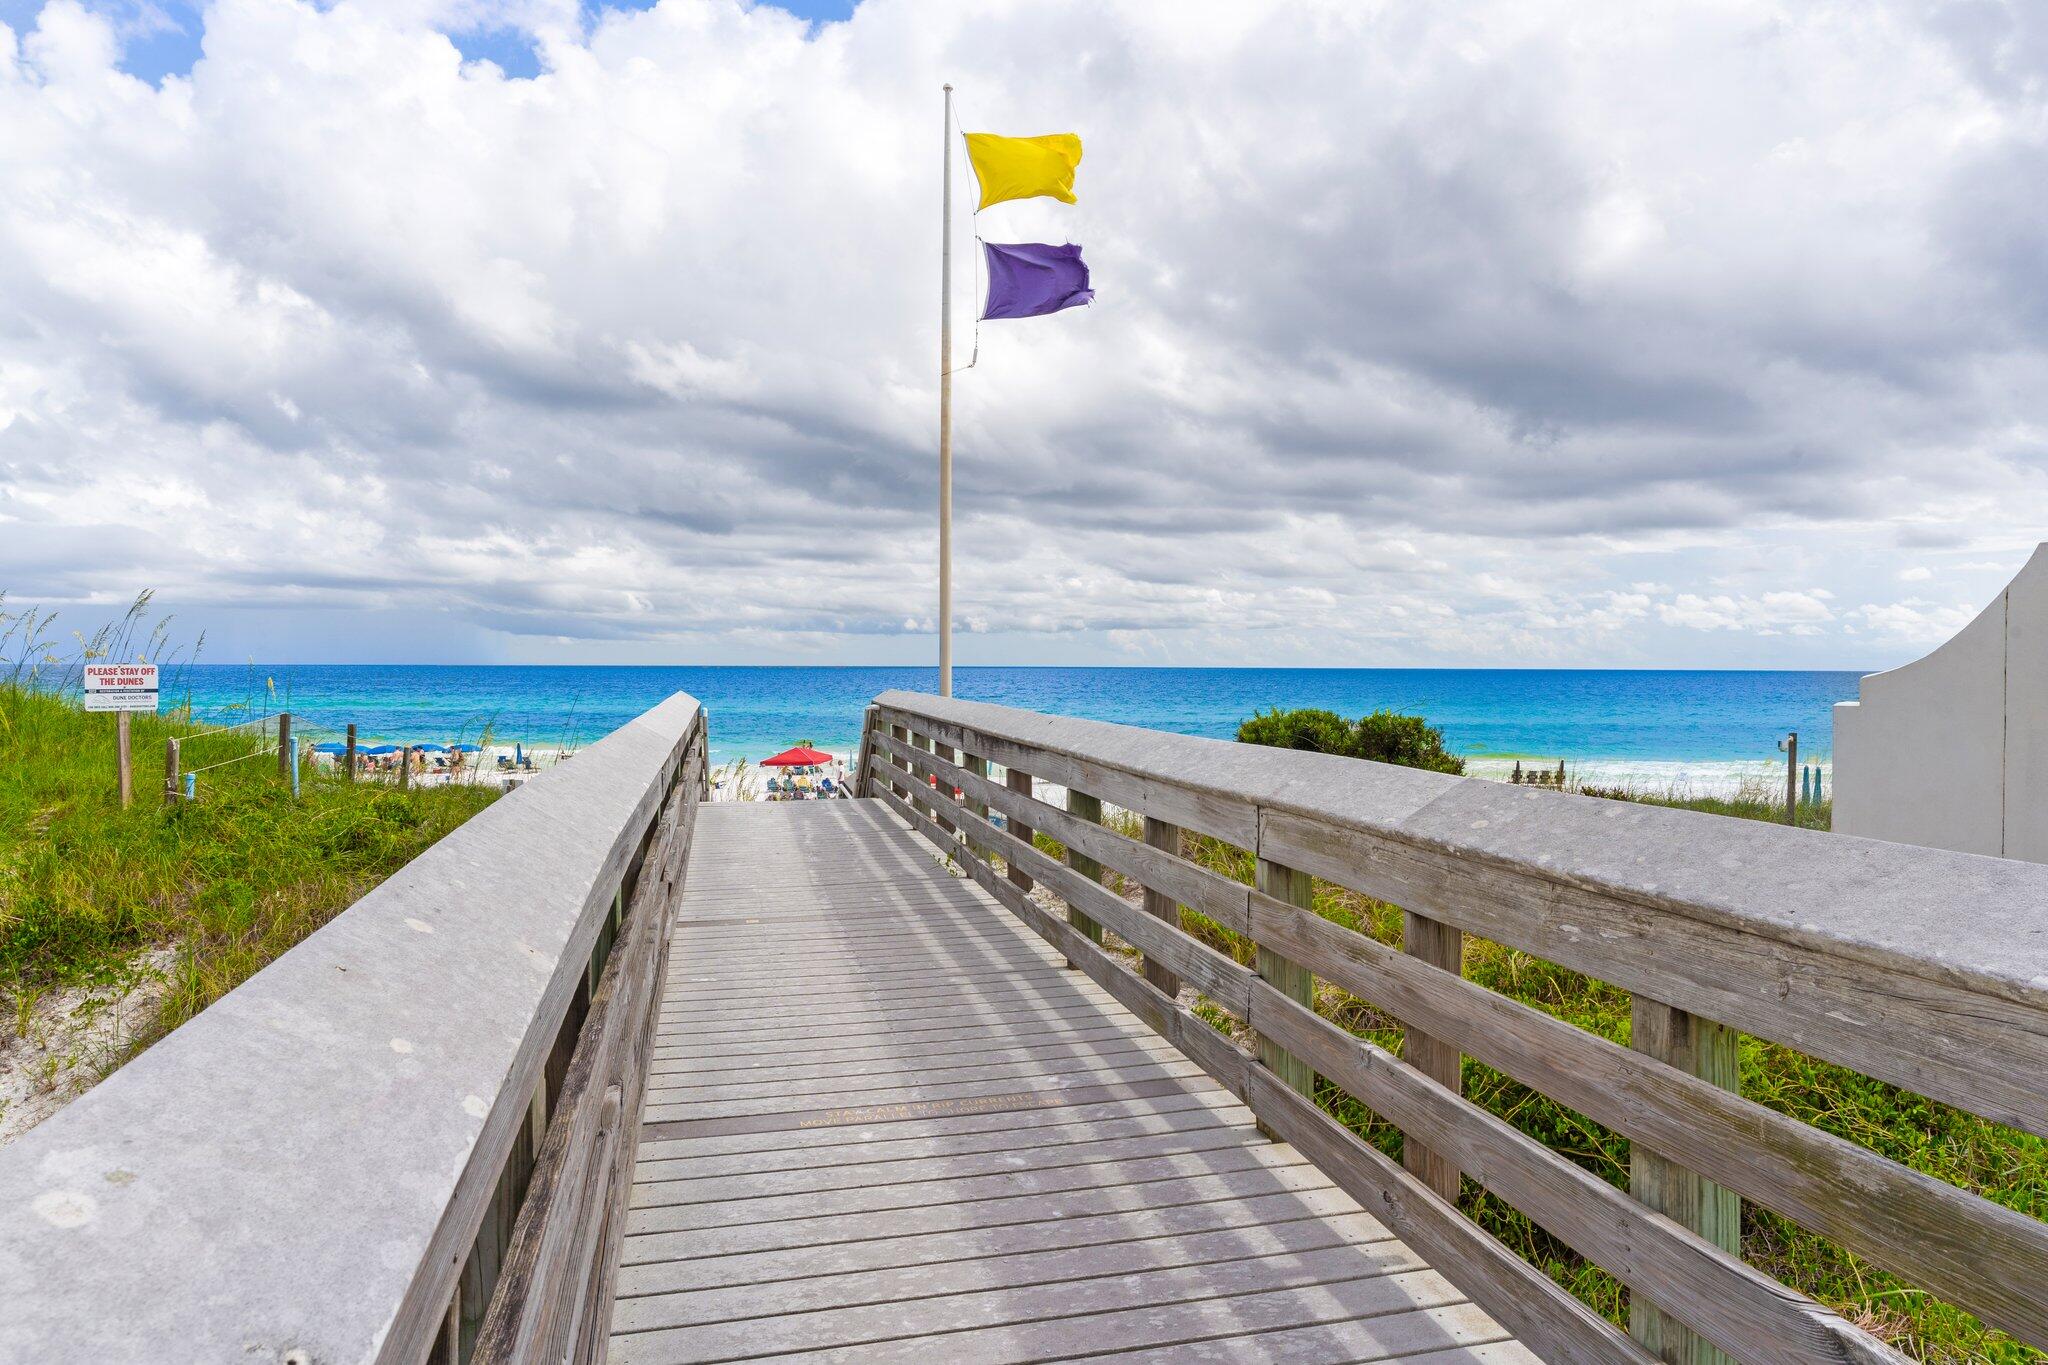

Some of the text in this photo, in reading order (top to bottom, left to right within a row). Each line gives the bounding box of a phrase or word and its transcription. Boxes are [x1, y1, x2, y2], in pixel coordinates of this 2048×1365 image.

[87, 667, 156, 676] PLEASE STAY OFF
[99, 677, 144, 686] THE DUNES
[866, 1106, 908, 1115] CALM
[912, 1103, 926, 1111] IN
[931, 1101, 954, 1109] RIP
[799, 1118, 841, 1128] MOVE
[845, 1112, 915, 1123] PARALLEL
[919, 1109, 938, 1117] TO
